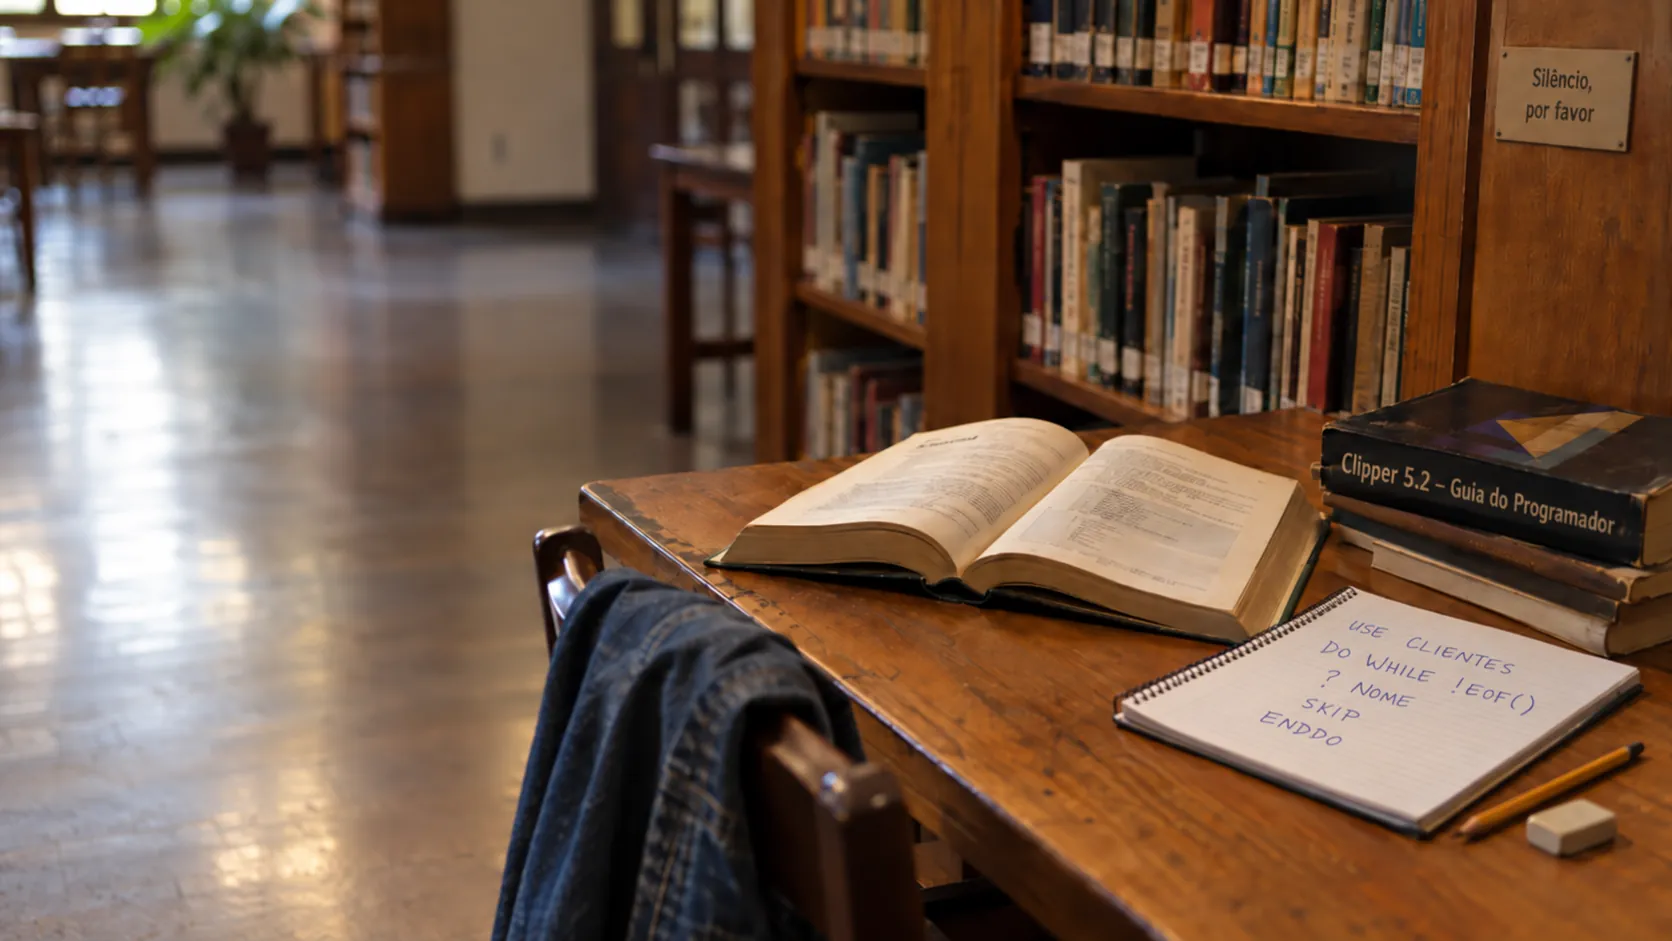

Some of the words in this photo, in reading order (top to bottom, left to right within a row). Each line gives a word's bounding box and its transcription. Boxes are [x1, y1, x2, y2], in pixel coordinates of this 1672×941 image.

[1532, 67, 1592, 94] Silêncio,
[1525, 103, 1550, 124] por
[1555, 100, 1595, 122] favor
[1341, 452, 1399, 486] Clipper
[1403, 466, 1431, 492] 5.2
[1450, 478, 1485, 504] Guia
[1489, 486, 1509, 510] do
[1513, 492, 1616, 535] Programador
[1348, 620, 1389, 638] USE
[1406, 637, 1516, 675] CLIENTES
[1320, 640, 1352, 659] DO
[1366, 653, 1436, 683] WHILE
[1450, 677, 1535, 716] !EOF()
[1320, 670, 1341, 688] ?
[1351, 681, 1416, 708] NOME
[1301, 698, 1361, 722] SKIP
[1259, 711, 1343, 746] ENDDO
